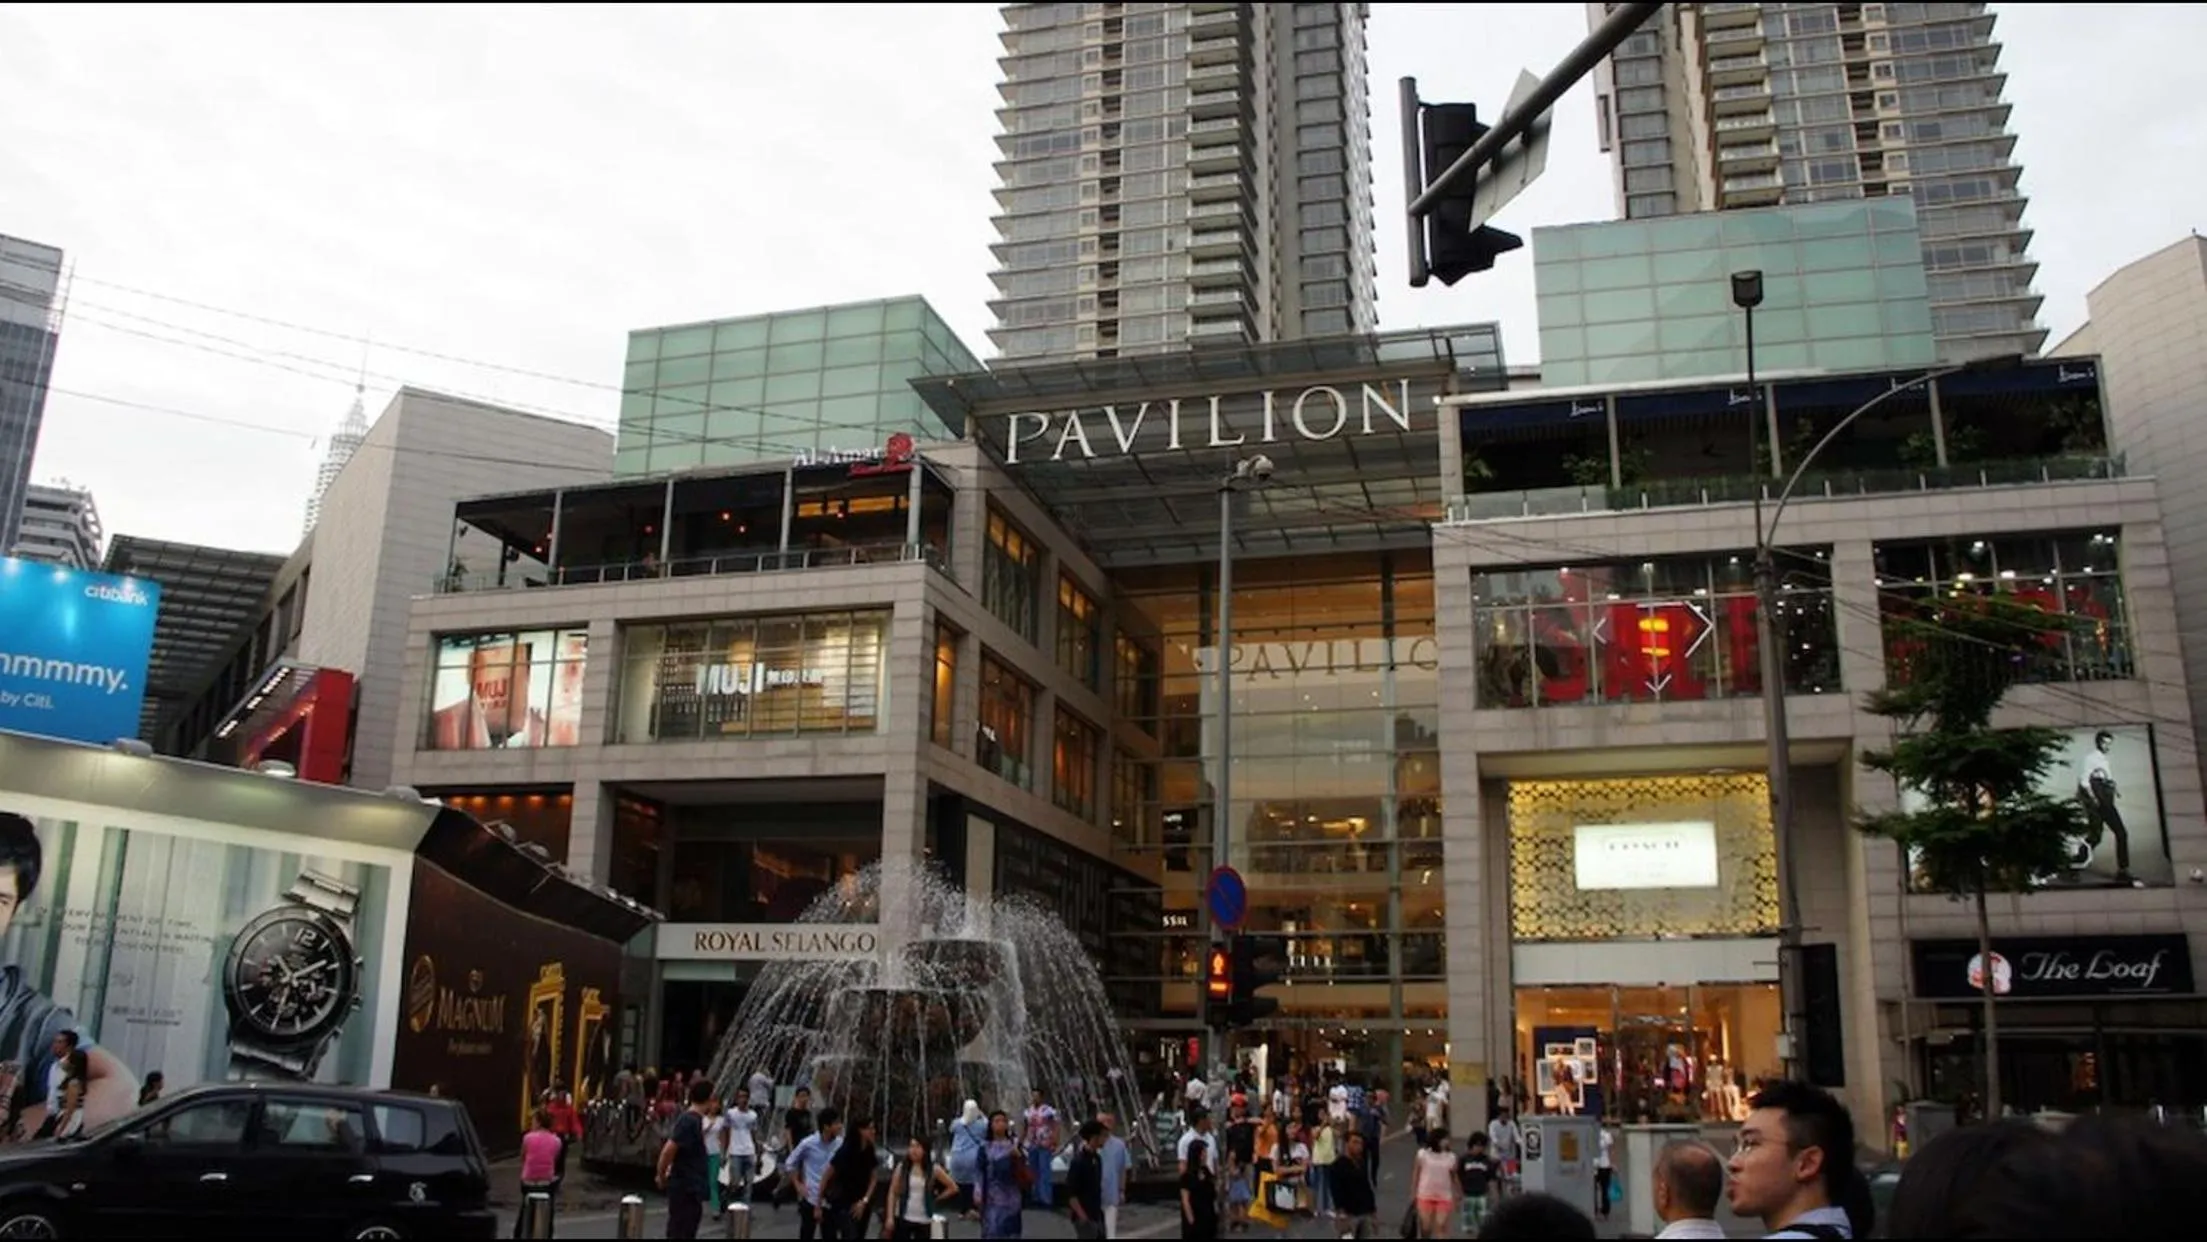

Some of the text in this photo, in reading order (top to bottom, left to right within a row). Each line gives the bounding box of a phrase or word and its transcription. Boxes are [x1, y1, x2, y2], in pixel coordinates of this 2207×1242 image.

[1005, 378, 1413, 464] PAVILION
[84, 585, 148, 606] citibank
[696, 662, 764, 695] MUJI
[1214, 637, 1438, 683] PAVILIO
[695, 931, 877, 953] ROYAL SELANGO
[2021, 950, 2168, 988] The Loaf
[437, 986, 505, 1033] MAGNUM
